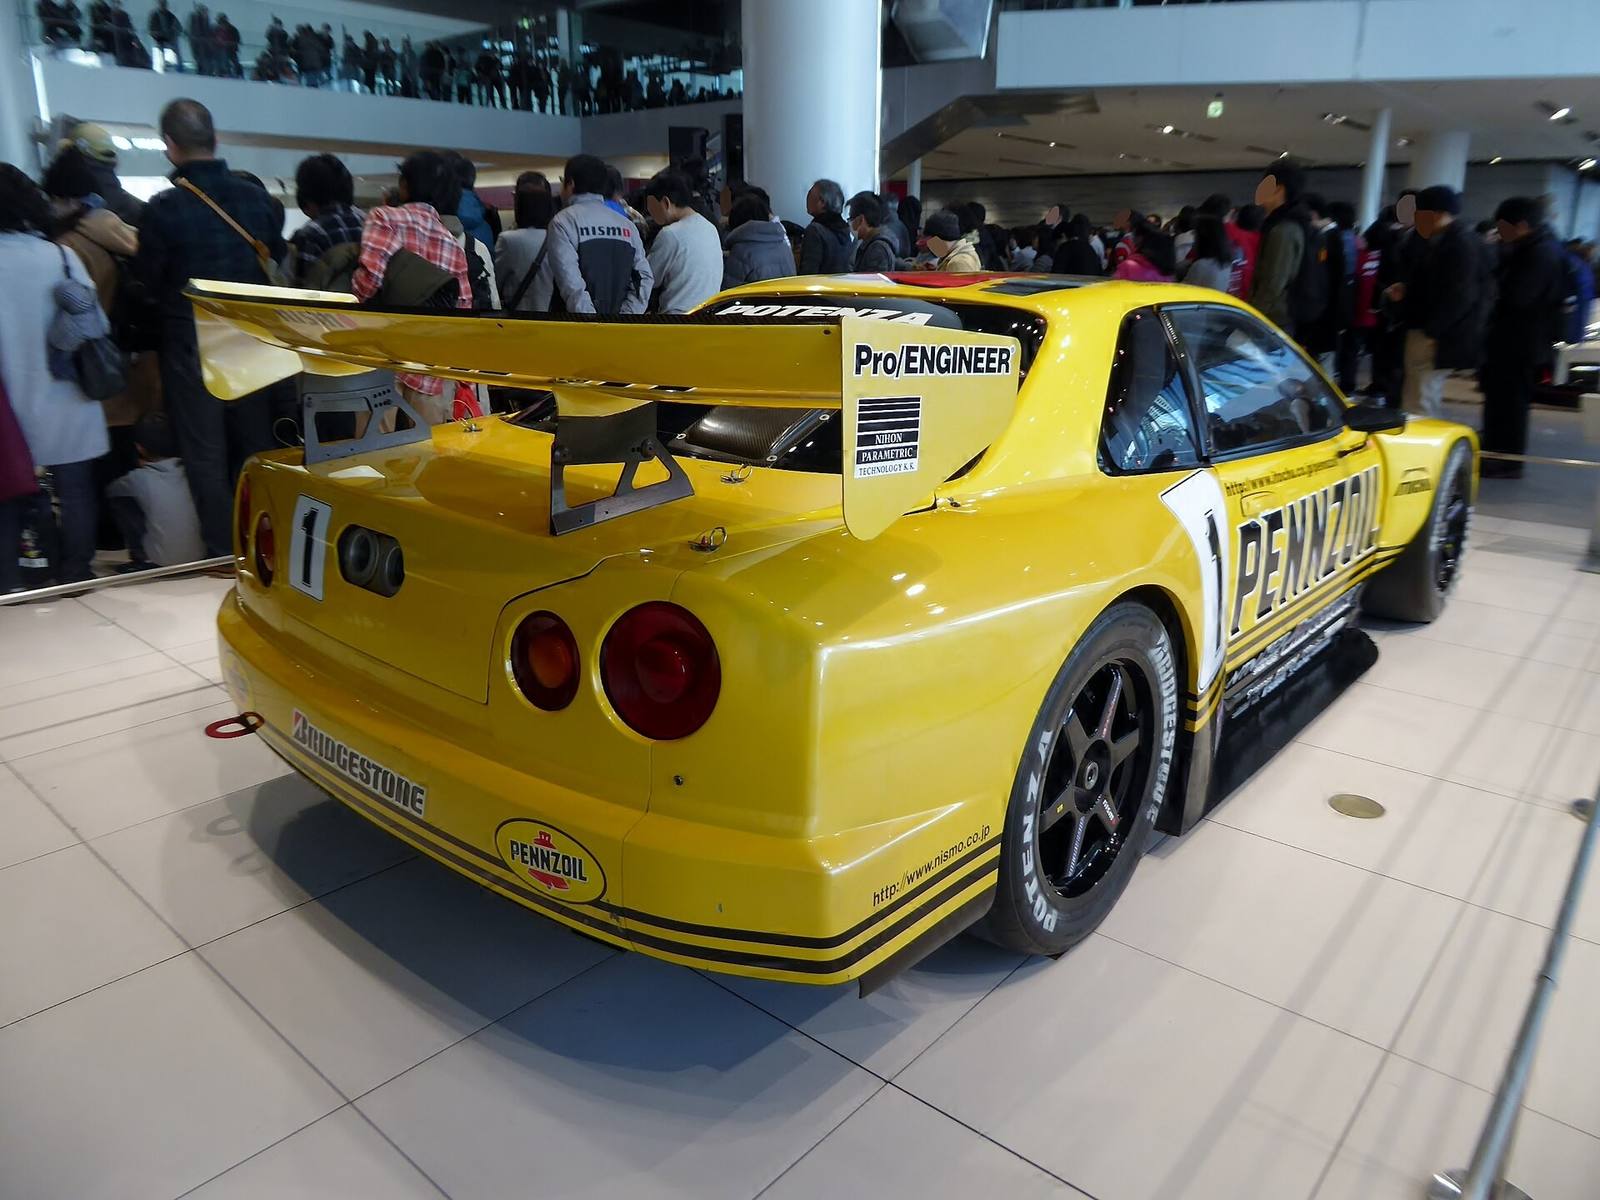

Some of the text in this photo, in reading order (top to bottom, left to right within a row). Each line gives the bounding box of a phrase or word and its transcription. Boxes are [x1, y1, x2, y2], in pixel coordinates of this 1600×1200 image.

[715, 304, 933, 327] POTENZA
[854, 343, 1012, 379] Pro/ENGINEER
[858, 463, 903, 476] TECHNOLOGY
[861, 447, 913, 463] PARAMETRIC
[875, 432, 903, 445] NIHON
[300, 506, 320, 588] 1
[1229, 464, 1381, 639] PENNZOIL
[1203, 508, 1223, 658] 1
[293, 709, 426, 816] BRIDGESTONE
[509, 838, 588, 883] PENNZOIL
[1022, 729, 1058, 933] POTENZA
[872, 824, 991, 907] http://www.nismo.co.jp
